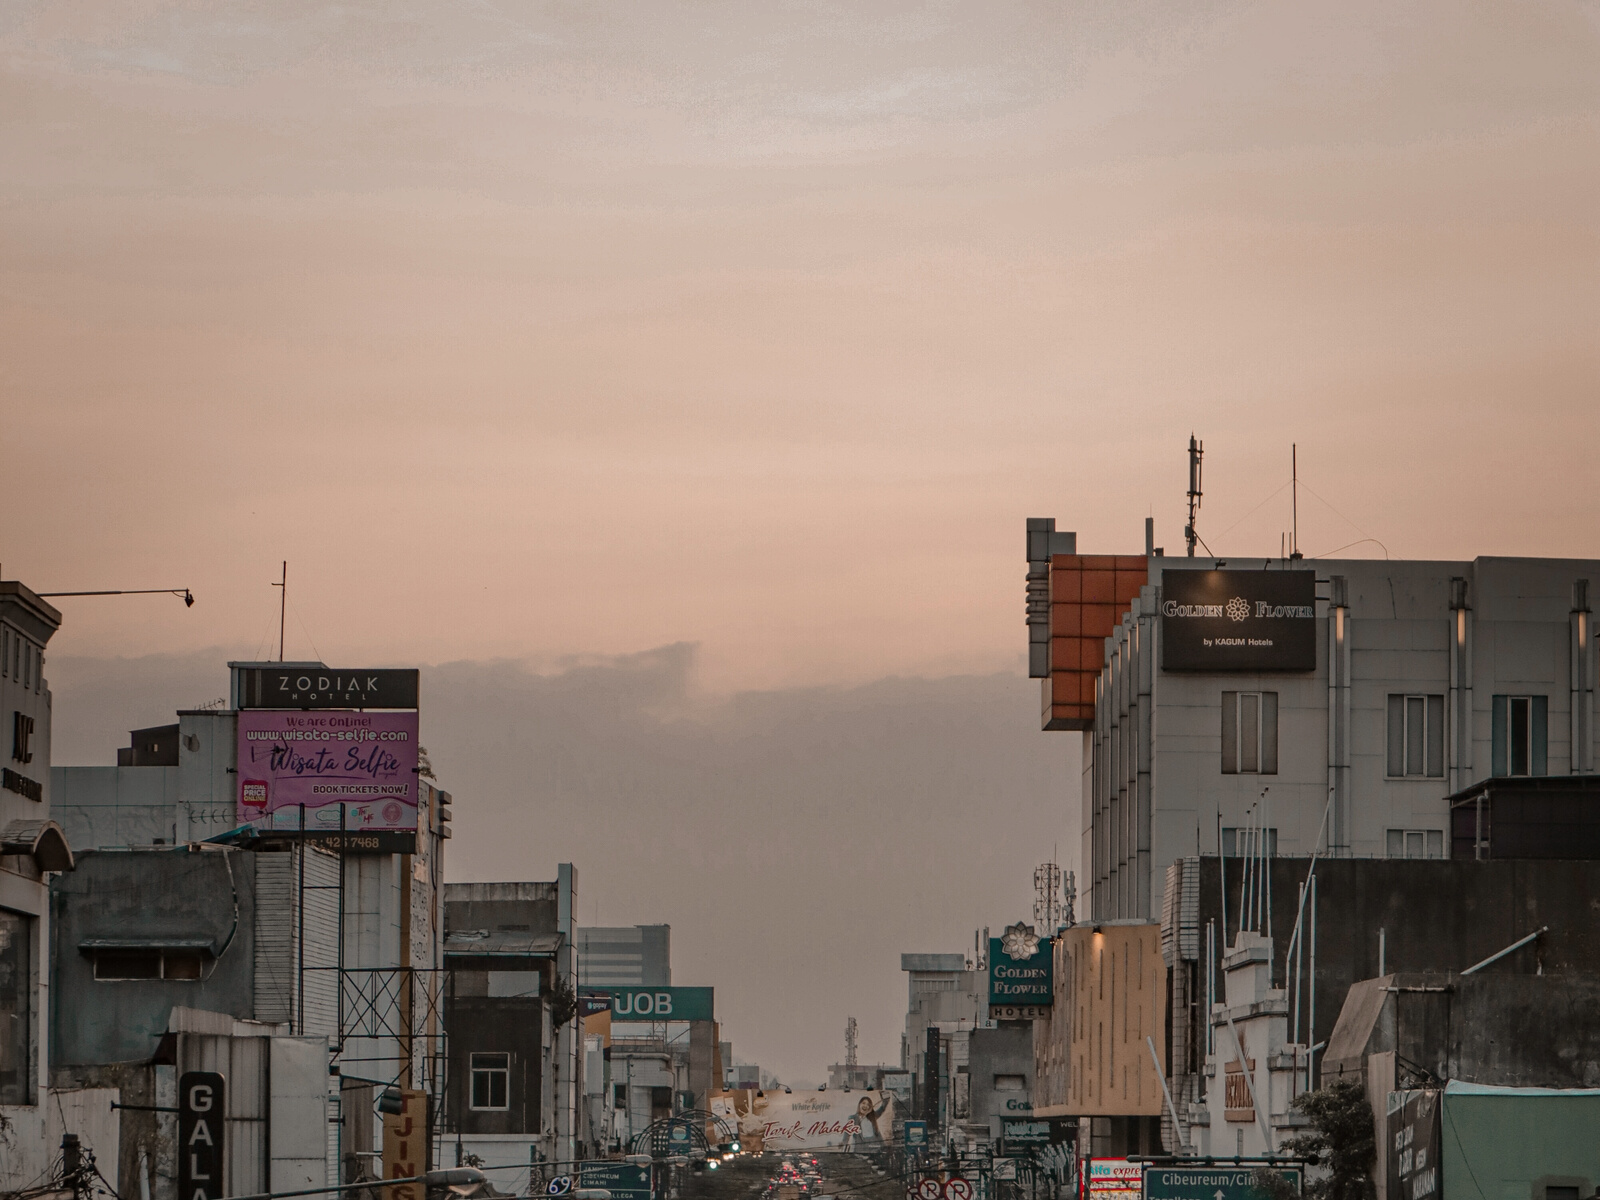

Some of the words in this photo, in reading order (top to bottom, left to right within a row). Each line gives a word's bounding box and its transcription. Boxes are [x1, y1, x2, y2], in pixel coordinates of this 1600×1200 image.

[1203, 638, 1213, 647] by
[1215, 638, 1246, 646] KAGUM
[1248, 638, 1273, 646] Hotels
[279, 676, 378, 691] ZODIAK
[286, 717, 306, 727] We
[246, 728, 408, 744] www.wisata-selfie.com
[270, 747, 339, 775] Wisata
[344, 745, 401, 778] Selfie
[313, 785, 338, 794] BOOK
[340, 785, 379, 794] TICKETS
[381, 784, 408, 795] NOW!
[350, 837, 380, 848] 7468
[592, 1002, 608, 1010] gopay
[614, 992, 673, 1014] UOB
[994, 1008, 1044, 1016] HOTEL
[791, 1102, 810, 1111] White
[811, 1102, 831, 1111] Koffie
[807, 1120, 861, 1136] Malaka
[549, 1176, 570, 1196] 69
